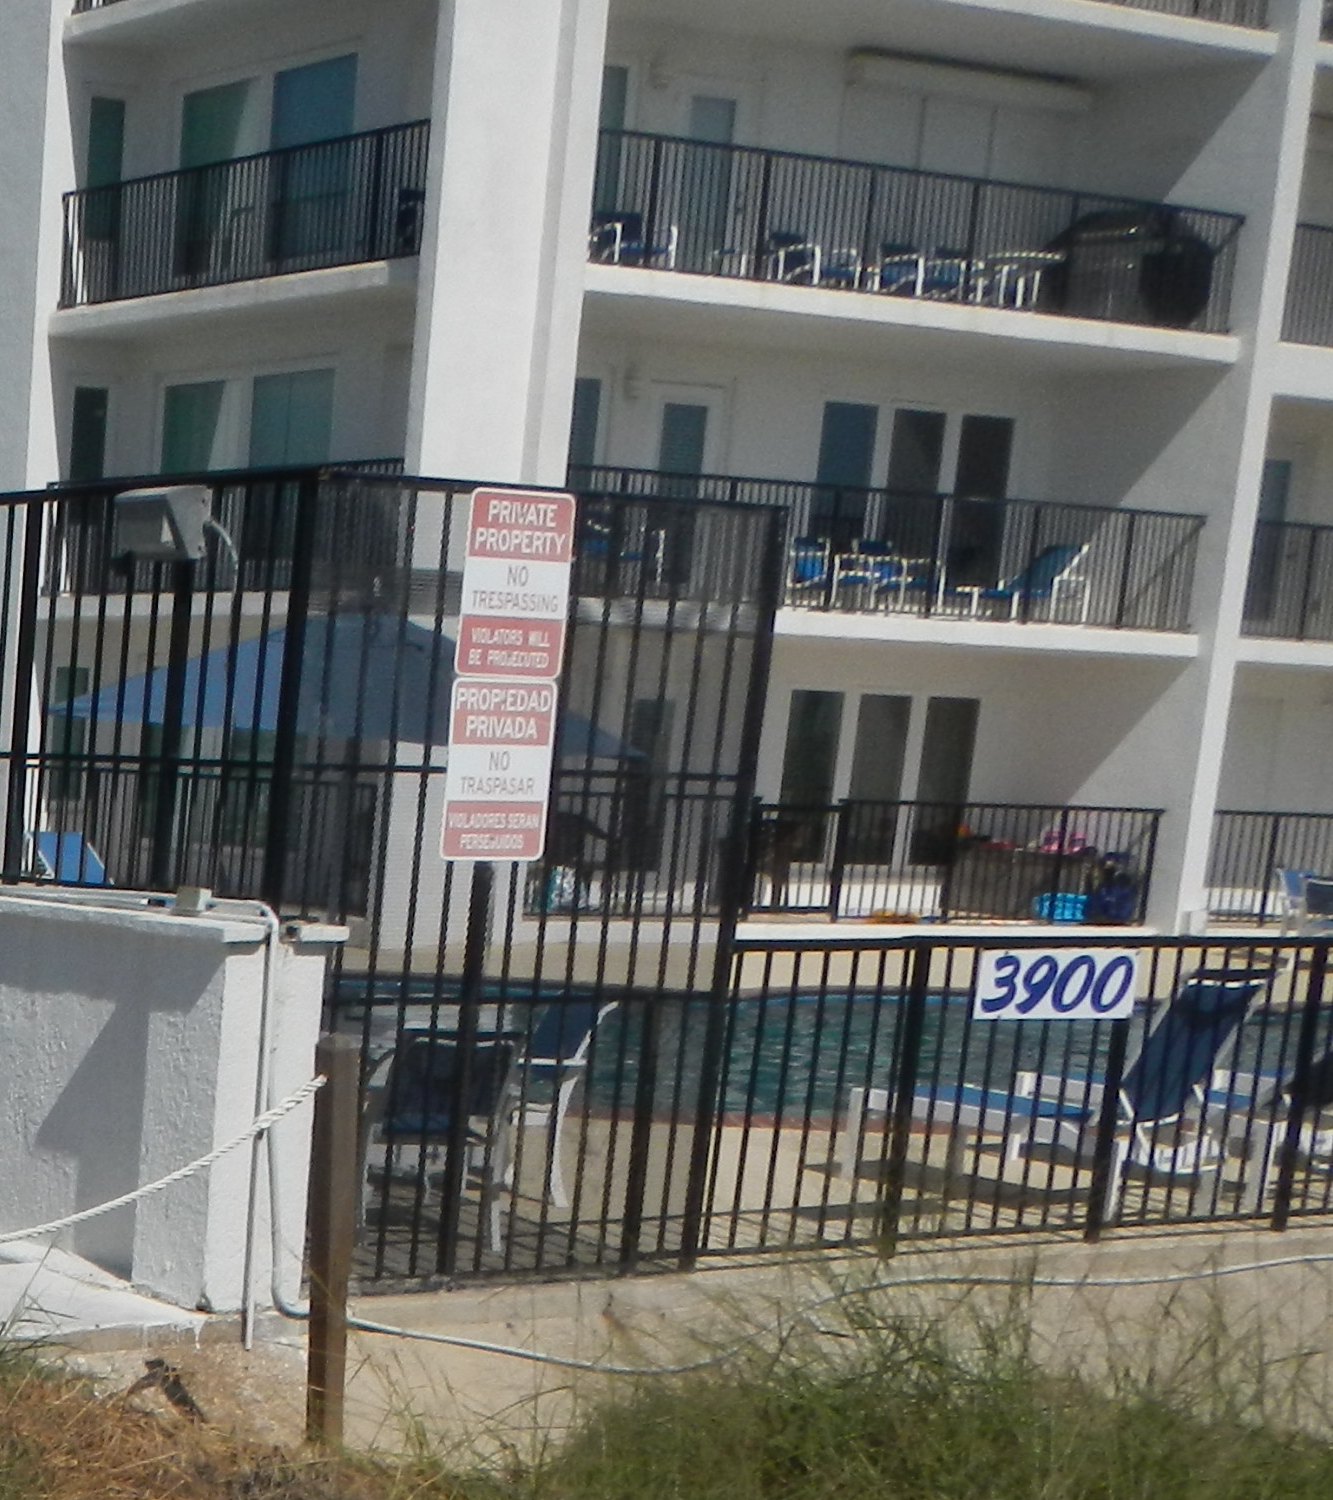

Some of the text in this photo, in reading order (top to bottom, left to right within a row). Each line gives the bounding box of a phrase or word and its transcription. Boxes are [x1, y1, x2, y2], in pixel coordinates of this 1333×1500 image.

[487, 501, 558, 527] PRIVATE
[474, 528, 566, 555] PROPERTY
[506, 565, 529, 587] NO
[471, 590, 559, 613] TRESPASSING
[471, 627, 550, 647] VIOLATORS WILL
[468, 649, 482, 665] BE
[465, 715, 539, 740] PRIVADA
[488, 751, 511, 771] NO
[460, 776, 535, 796] TRASPASAR
[981, 955, 1134, 1014] 3900
